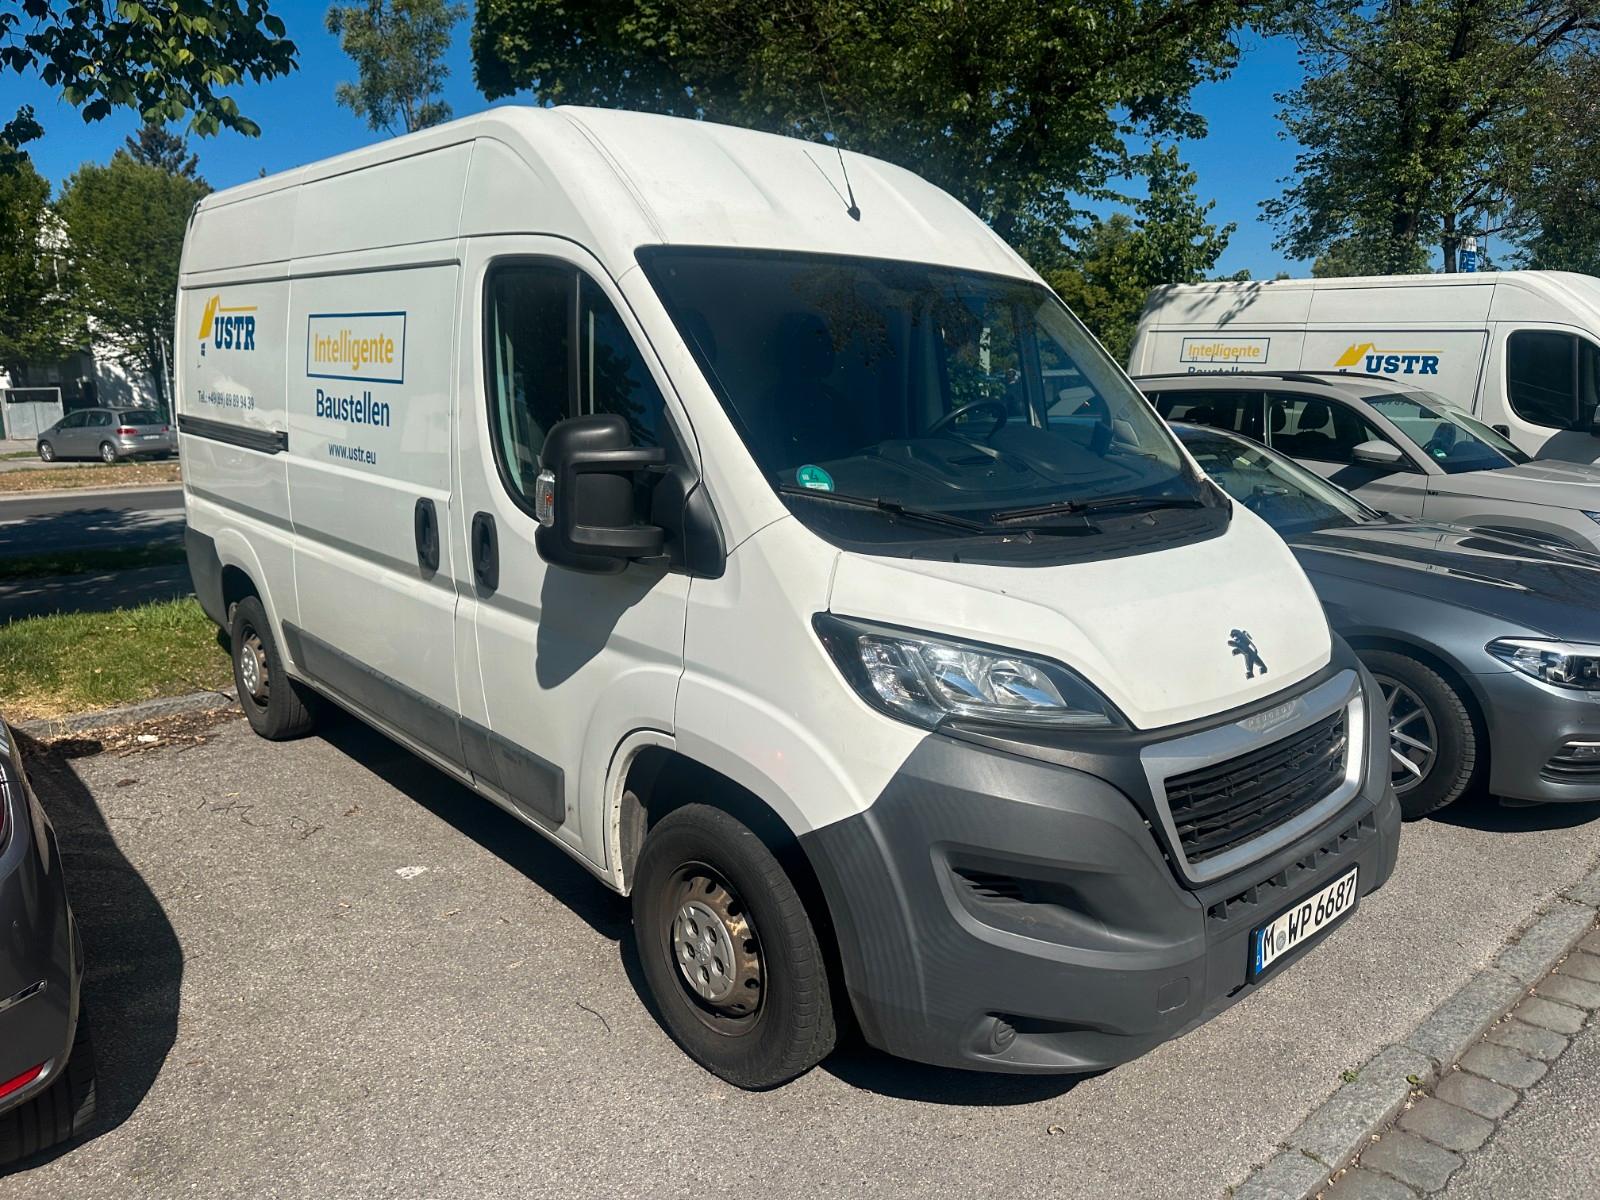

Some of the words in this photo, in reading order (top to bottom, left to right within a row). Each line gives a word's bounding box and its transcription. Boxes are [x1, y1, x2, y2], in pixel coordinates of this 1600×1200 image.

[214, 316, 255, 350] USTR
[314, 330, 393, 371] Intelligente
[1188, 344, 1260, 359] Intelligente
[1366, 355, 1439, 374] USTR
[316, 388, 390, 427] Baustellen
[328, 442, 376, 465] www.ustr.eu
[1263, 923, 1275, 961] M
[1288, 903, 1312, 944] WP
[1314, 873, 1356, 926] 6687
